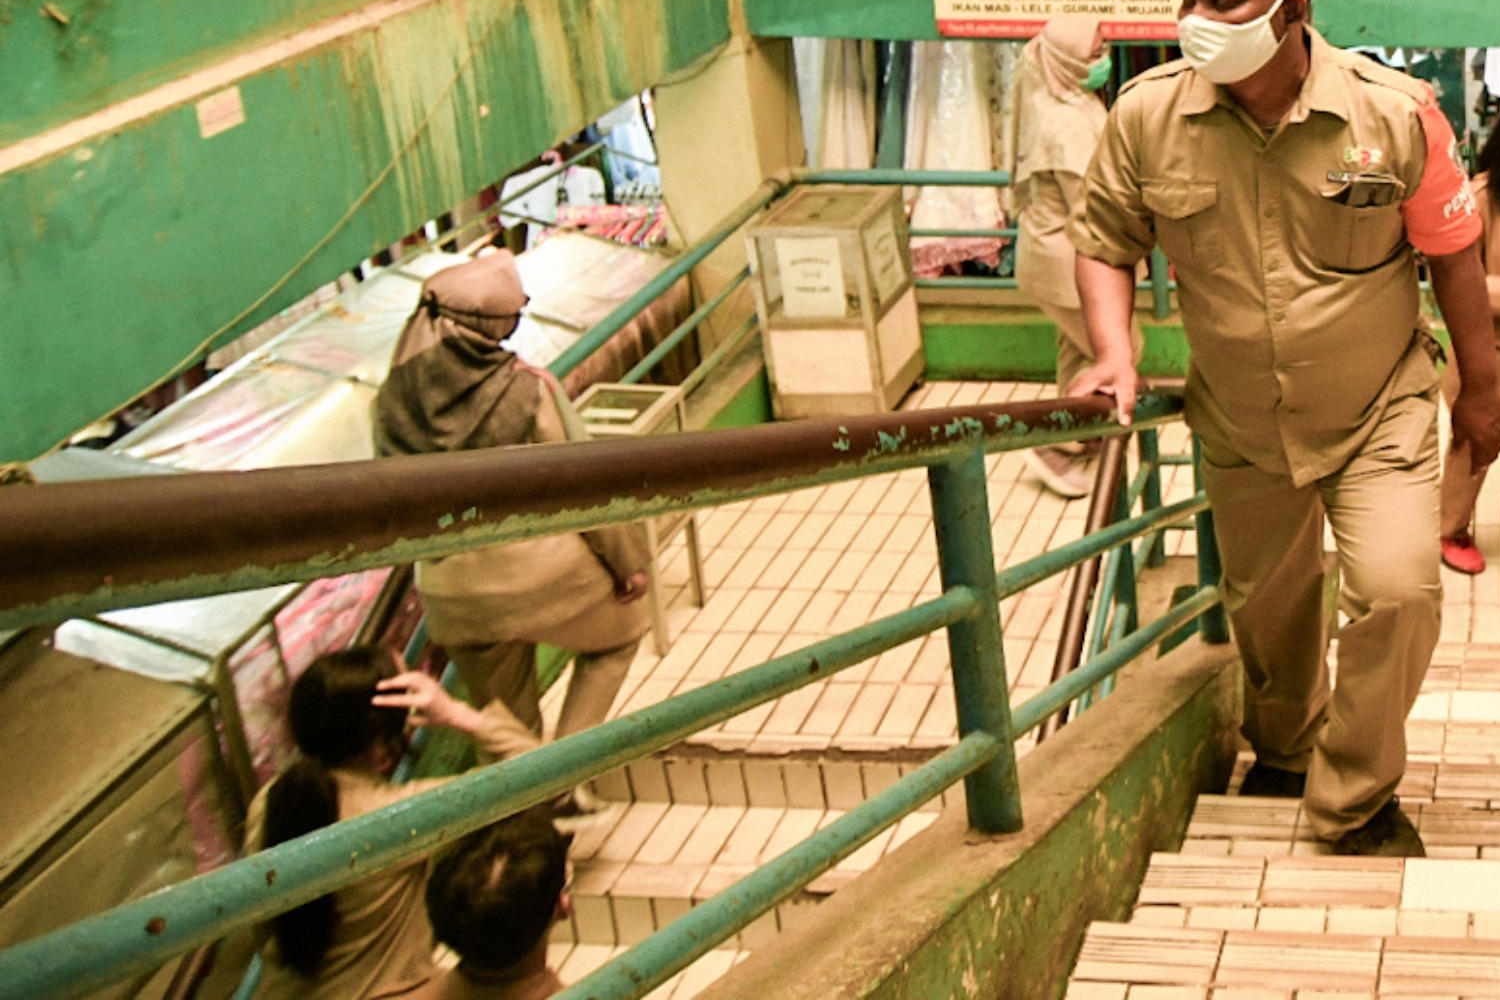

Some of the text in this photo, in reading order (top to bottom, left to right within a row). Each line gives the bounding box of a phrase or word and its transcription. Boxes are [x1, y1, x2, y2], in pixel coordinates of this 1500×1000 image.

[952, 3, 981, 13] IKAN
[984, 3, 1011, 14] MAS
[1022, 3, 1050, 14] LELE
[1063, 4, 1116, 15] GURAME
[1127, 5, 1173, 15] MUJAIR
